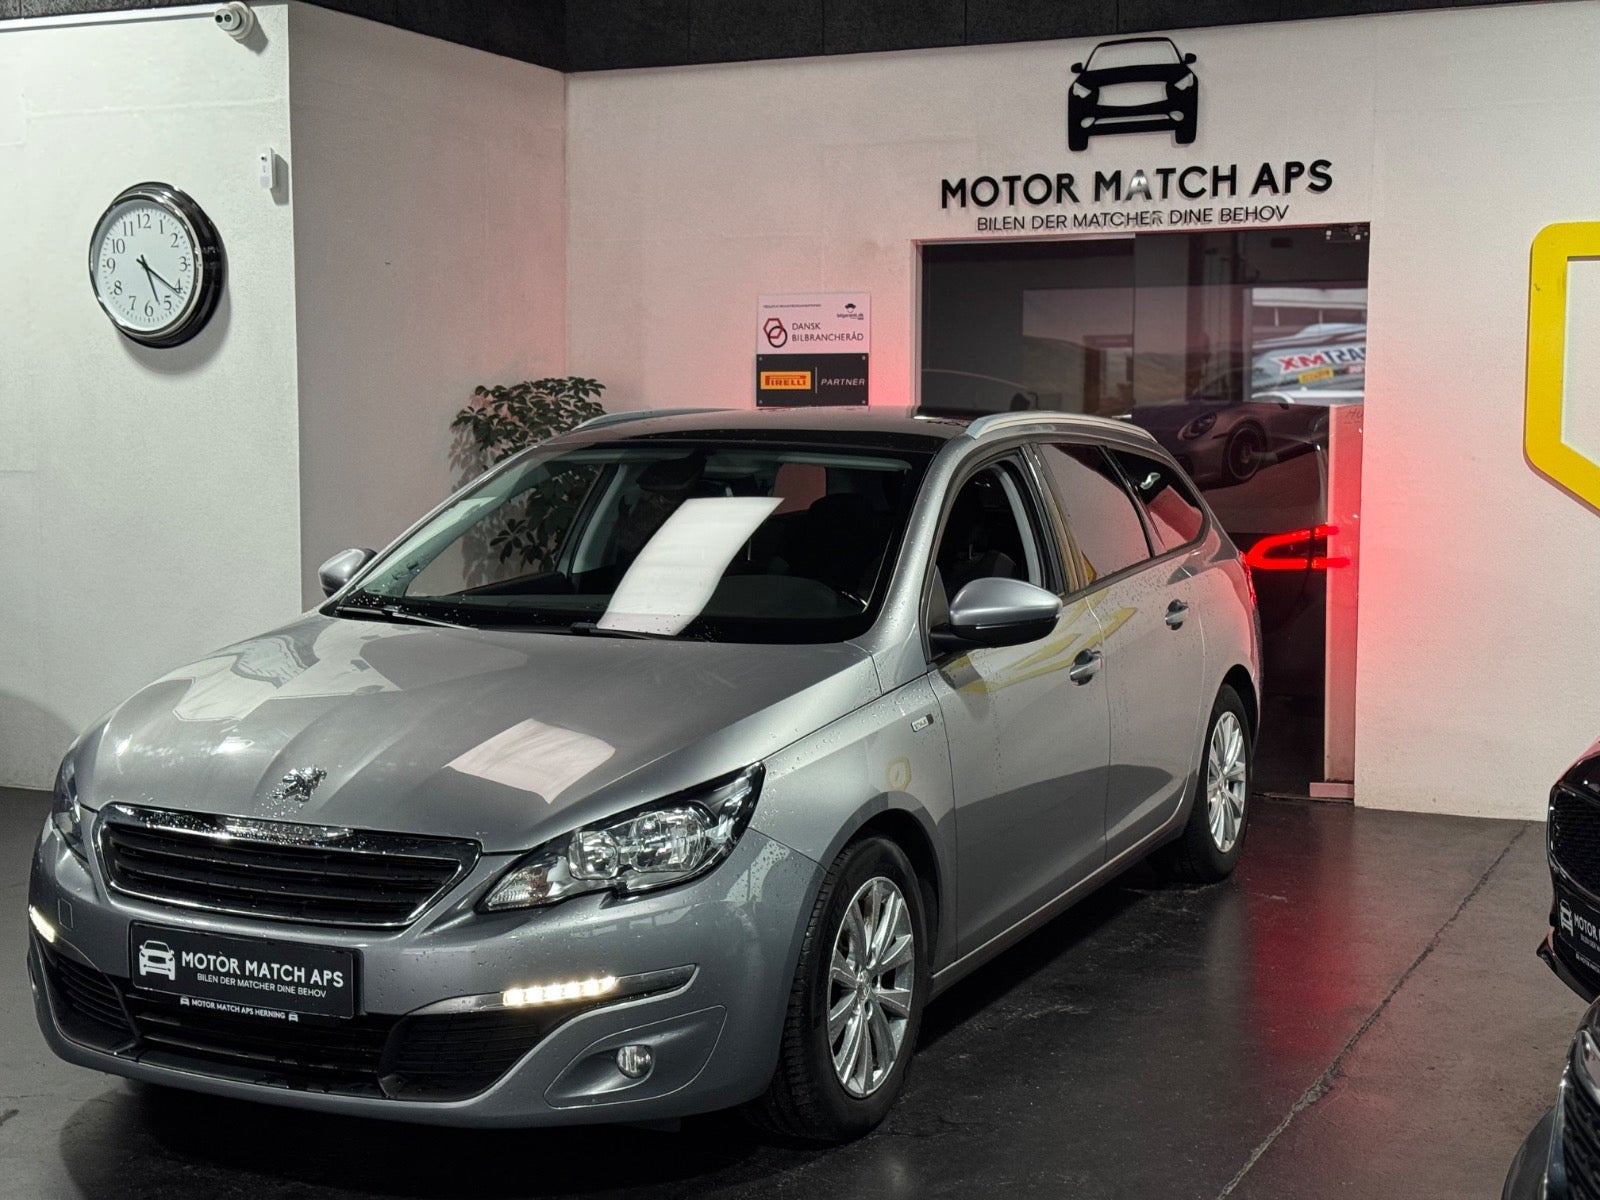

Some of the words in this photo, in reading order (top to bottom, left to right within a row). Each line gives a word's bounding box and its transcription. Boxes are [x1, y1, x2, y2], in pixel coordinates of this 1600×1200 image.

[941, 172, 1080, 209] MOTOR
[1094, 163, 1237, 203] MATCH
[1251, 158, 1333, 195] APS
[137, 213, 152, 229] 12
[977, 215, 1026, 231] BILEN
[1031, 214, 1067, 230] DER
[1073, 210, 1164, 229] MATCHER
[1170, 207, 1213, 225] DINE
[1220, 205, 1290, 223] BEHOV
[123, 220, 134, 236] 11
[160, 219, 164, 234] 1
[112, 238, 126, 254] 10
[170, 233, 179, 248] 2
[106, 258, 116, 274] 9
[179, 256, 188, 272] 3
[113, 280, 123, 295] 8
[174, 277, 183, 294] 4
[128, 295, 137, 310] 7
[144, 300, 154, 317] 6
[163, 295, 172, 310] 5
[792, 322, 821, 331] DANSK
[792, 331, 864, 342] BILBRANCHERÅD
[765, 375, 807, 386] PIRELLI
[821, 378, 865, 386] PARTNER
[1574, 912, 1598, 941] MOTOR
[181, 951, 241, 975] MOTOR
[245, 960, 305, 983] MATCH
[310, 969, 344, 988] APS
[197, 972, 219, 984] BILEN
[220, 976, 236, 986] DER
[237, 979, 275, 992] MATCHER
[277, 984, 296, 995] DINE
[297, 986, 327, 998] BEHOV
[191, 998, 216, 1010] MOTOR
[216, 1003, 240, 1013] MATCH
[241, 1007, 254, 1015] APS
[255, 1009, 286, 1019] HERNING
